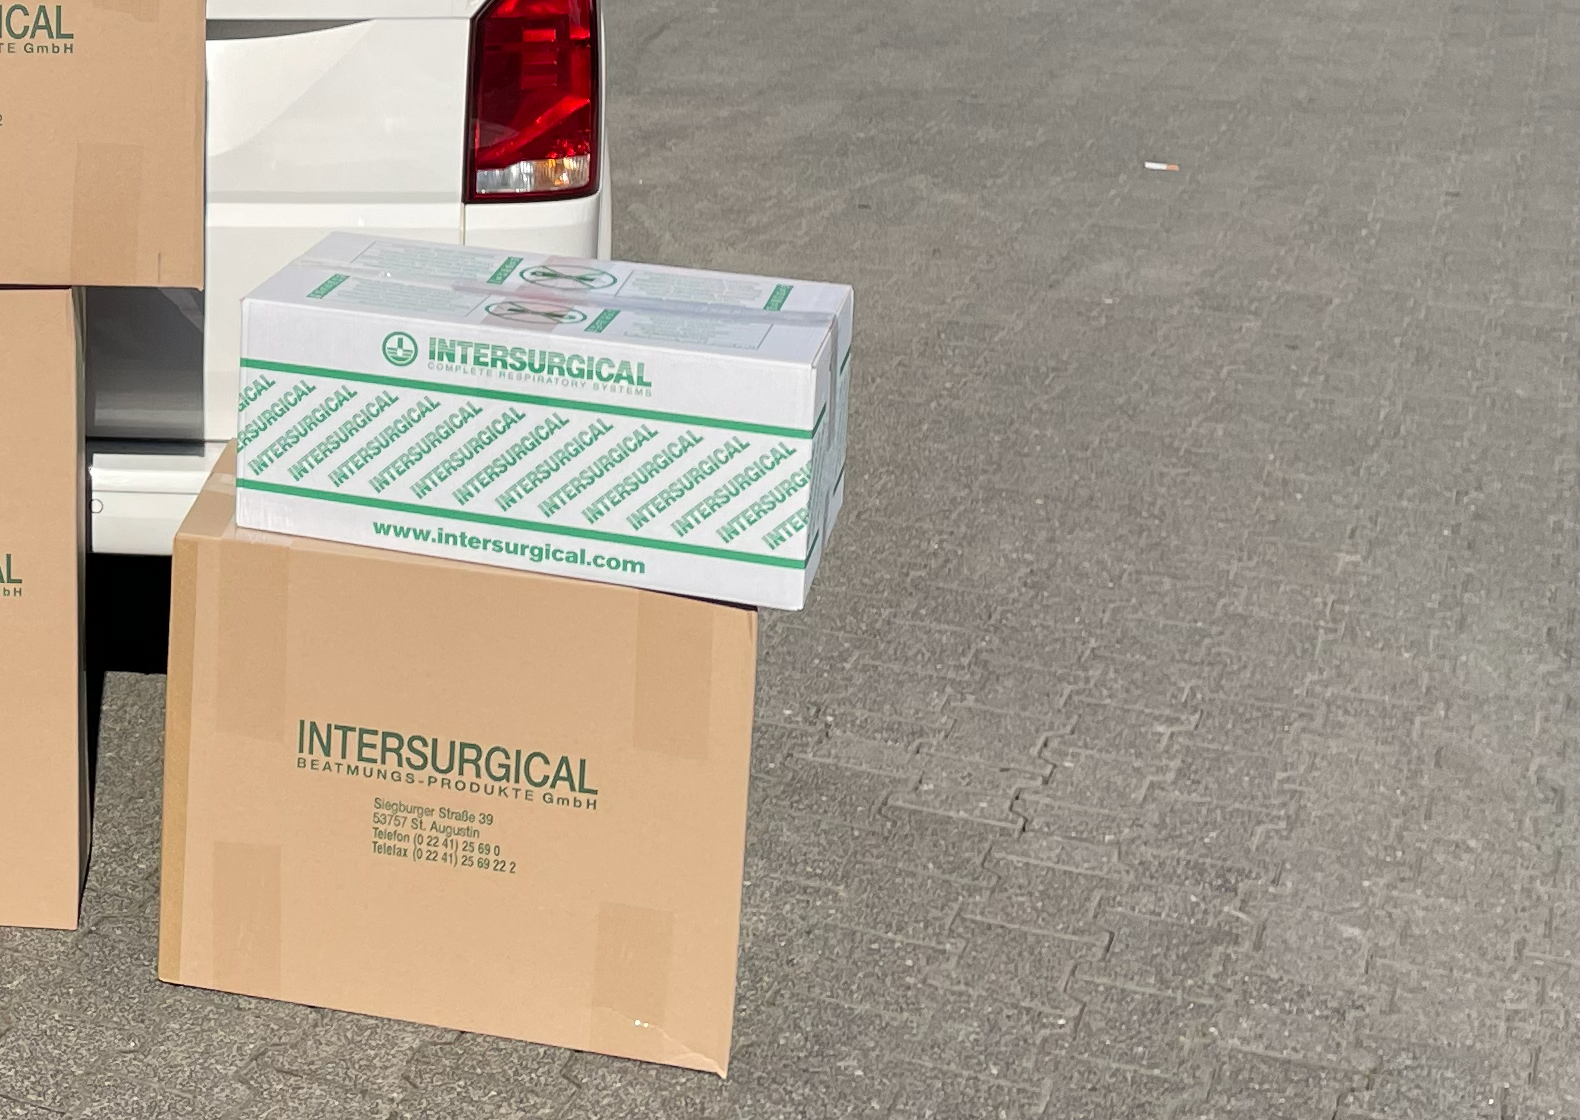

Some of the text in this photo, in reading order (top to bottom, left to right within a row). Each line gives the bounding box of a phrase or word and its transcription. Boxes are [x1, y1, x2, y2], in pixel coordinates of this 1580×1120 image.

[24, 43, 74, 54] GmbH
[428, 362, 651, 397] COMPLETE RESPIRATORY SYSTEMS
[429, 337, 652, 387] INTERSURGICAL
[247, 384, 358, 476] INTERSURGICAL
[287, 390, 399, 482] INTERSURGICAL
[327, 395, 442, 488] INTERSURGICAL
[368, 400, 484, 494] INTERSURGICAL
[409, 406, 527, 500] INTERSURGICAL
[451, 412, 570, 506] INTERSURGICAL
[494, 417, 614, 512] INTERSURGICAL
[537, 423, 659, 518] INTERSURGICAL
[580, 429, 704, 525] INTERSURGICAL
[625, 435, 751, 531] INTERSURGICAL
[670, 441, 797, 537] INTERSURGICAL
[373, 521, 645, 574] www.intersurgical.com
[297, 758, 597, 810] BEATMUNGS-PRODUKTE GmbH
[298, 719, 598, 795] INTERSURGICAL
[372, 841, 516, 874] Telefax (0 22 41) 25 69 22 2
[373, 812, 480, 839] 53757 St. Augustin
[373, 827, 500, 856] Telefon (0 22 41) 25 69 0
[374, 798, 494, 825] Siegburger Straße 39
